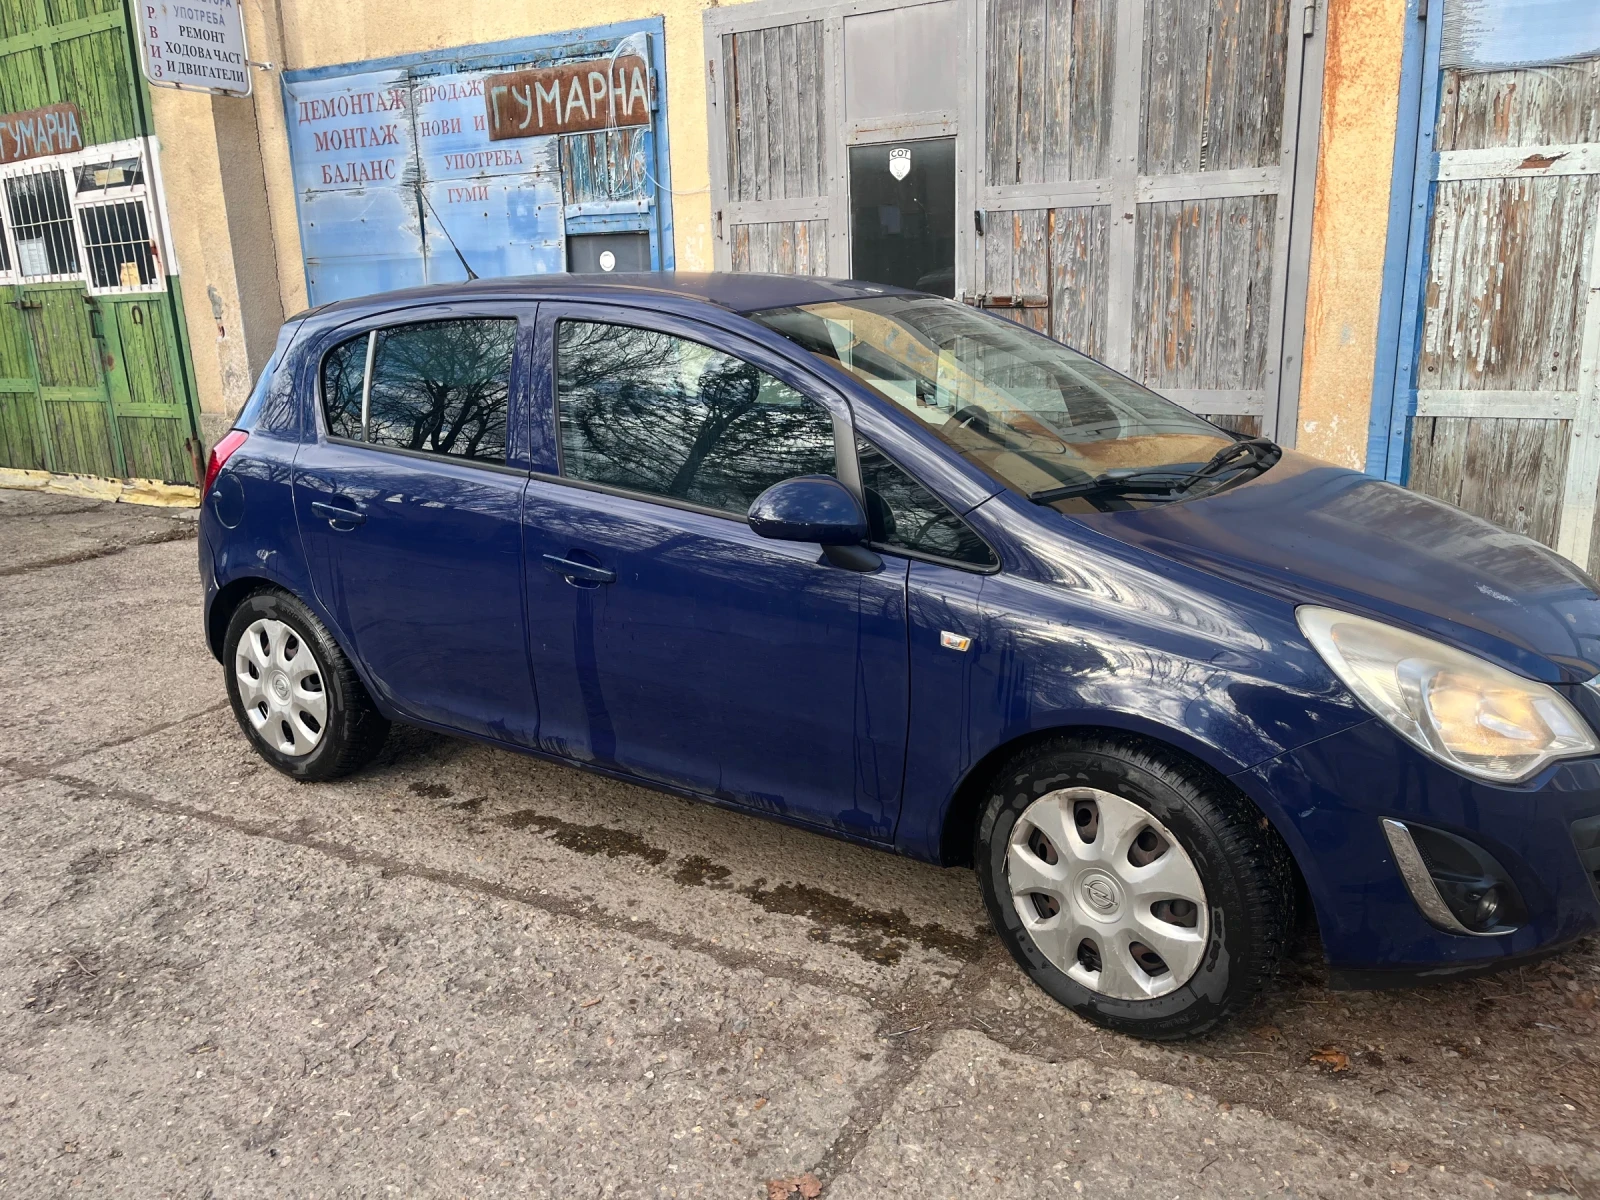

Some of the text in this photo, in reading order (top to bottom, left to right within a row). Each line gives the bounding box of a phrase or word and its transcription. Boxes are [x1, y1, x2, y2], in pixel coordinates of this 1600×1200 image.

[173, 5, 225, 26] УПОТРЕБА
[178, 25, 226, 44] РЕМОНТ
[164, 41, 241, 65] ХОДОВА ЧАСТ
[166, 59, 245, 83] И ДВИГАТЕЛИ
[418, 79, 486, 104] ПРОДАЖ
[490, 66, 649, 130] ГУМАРНА
[298, 88, 407, 126] ДЕМОНТАЖ
[0, 110, 83, 159] ГУМАРНА
[313, 123, 400, 153] МОНТАЖ
[420, 114, 487, 138] НОВИ И
[321, 158, 397, 185] БАЛАНС
[444, 149, 524, 171] УПОТРЕБА
[447, 186, 490, 204] ГУМИ
